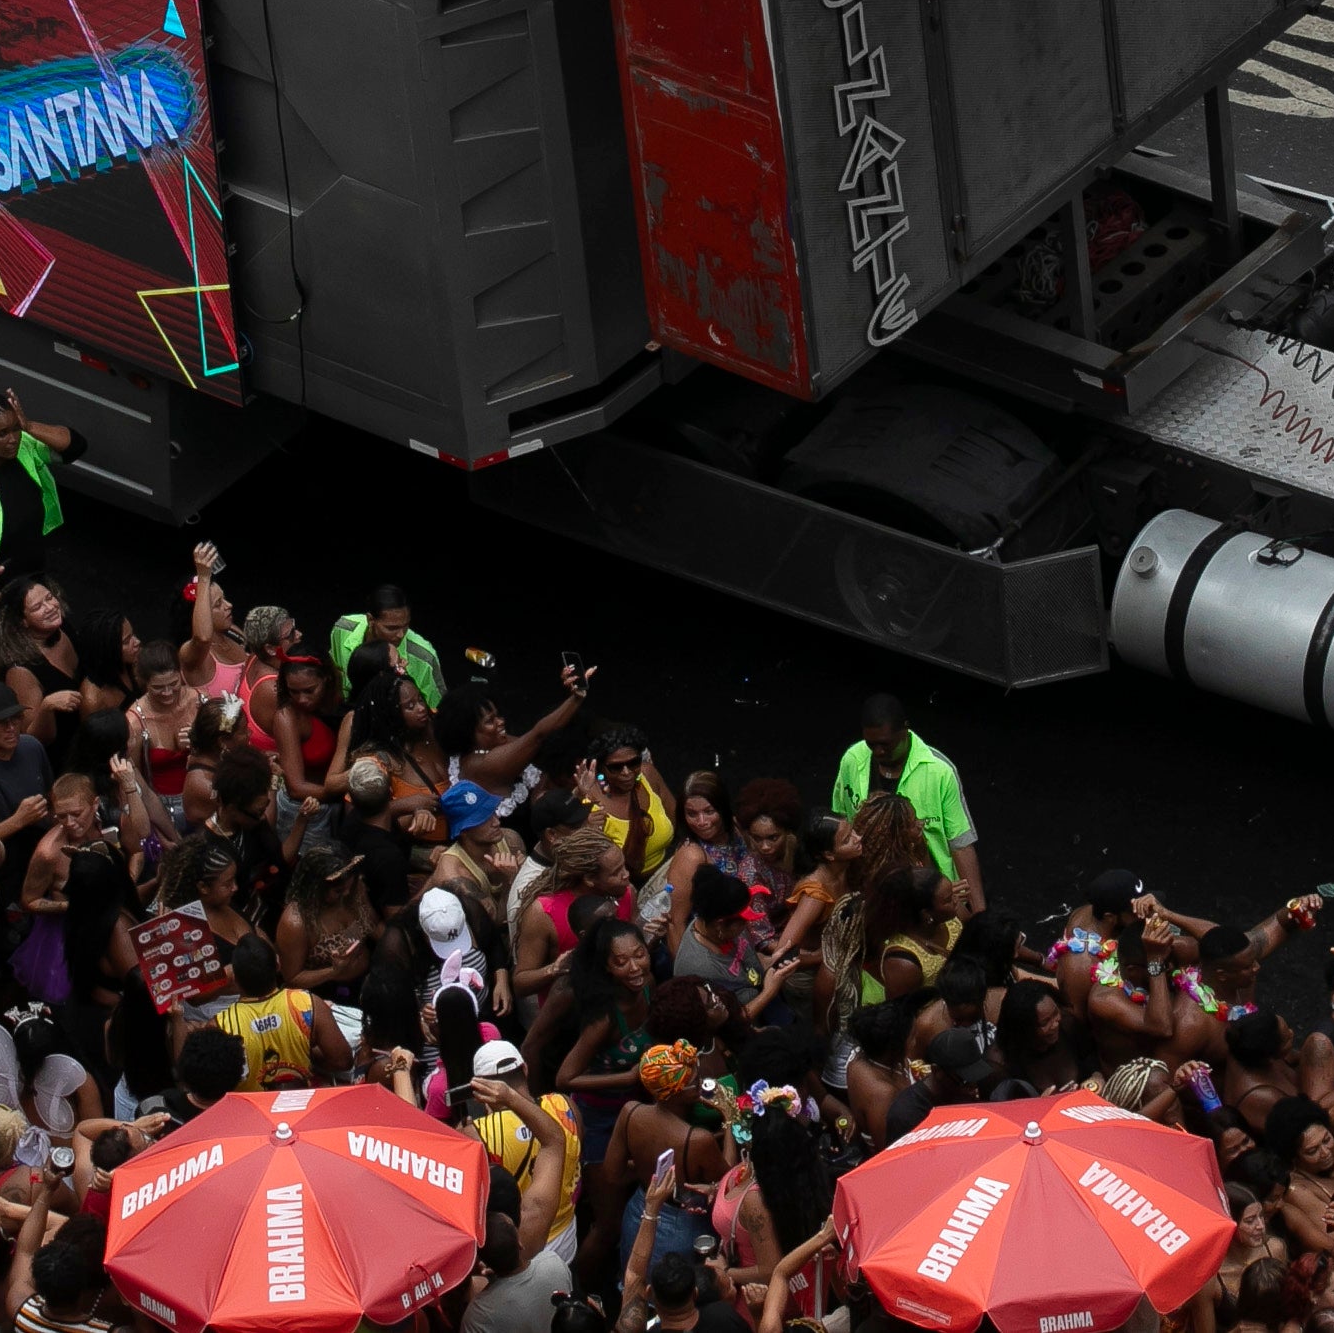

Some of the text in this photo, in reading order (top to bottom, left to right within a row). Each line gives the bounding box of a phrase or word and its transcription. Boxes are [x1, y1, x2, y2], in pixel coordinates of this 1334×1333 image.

[121, 1144, 224, 1219] BRAHMA
[347, 1131, 464, 1194] BRAHMA
[267, 1183, 305, 1302] BRAHMA
[917, 1176, 1011, 1283] BRAHMA
[1077, 1161, 1191, 1256] BRAHMA
[140, 1292, 176, 1325] BRAHMA
[1039, 1311, 1094, 1333] BRAHMA
